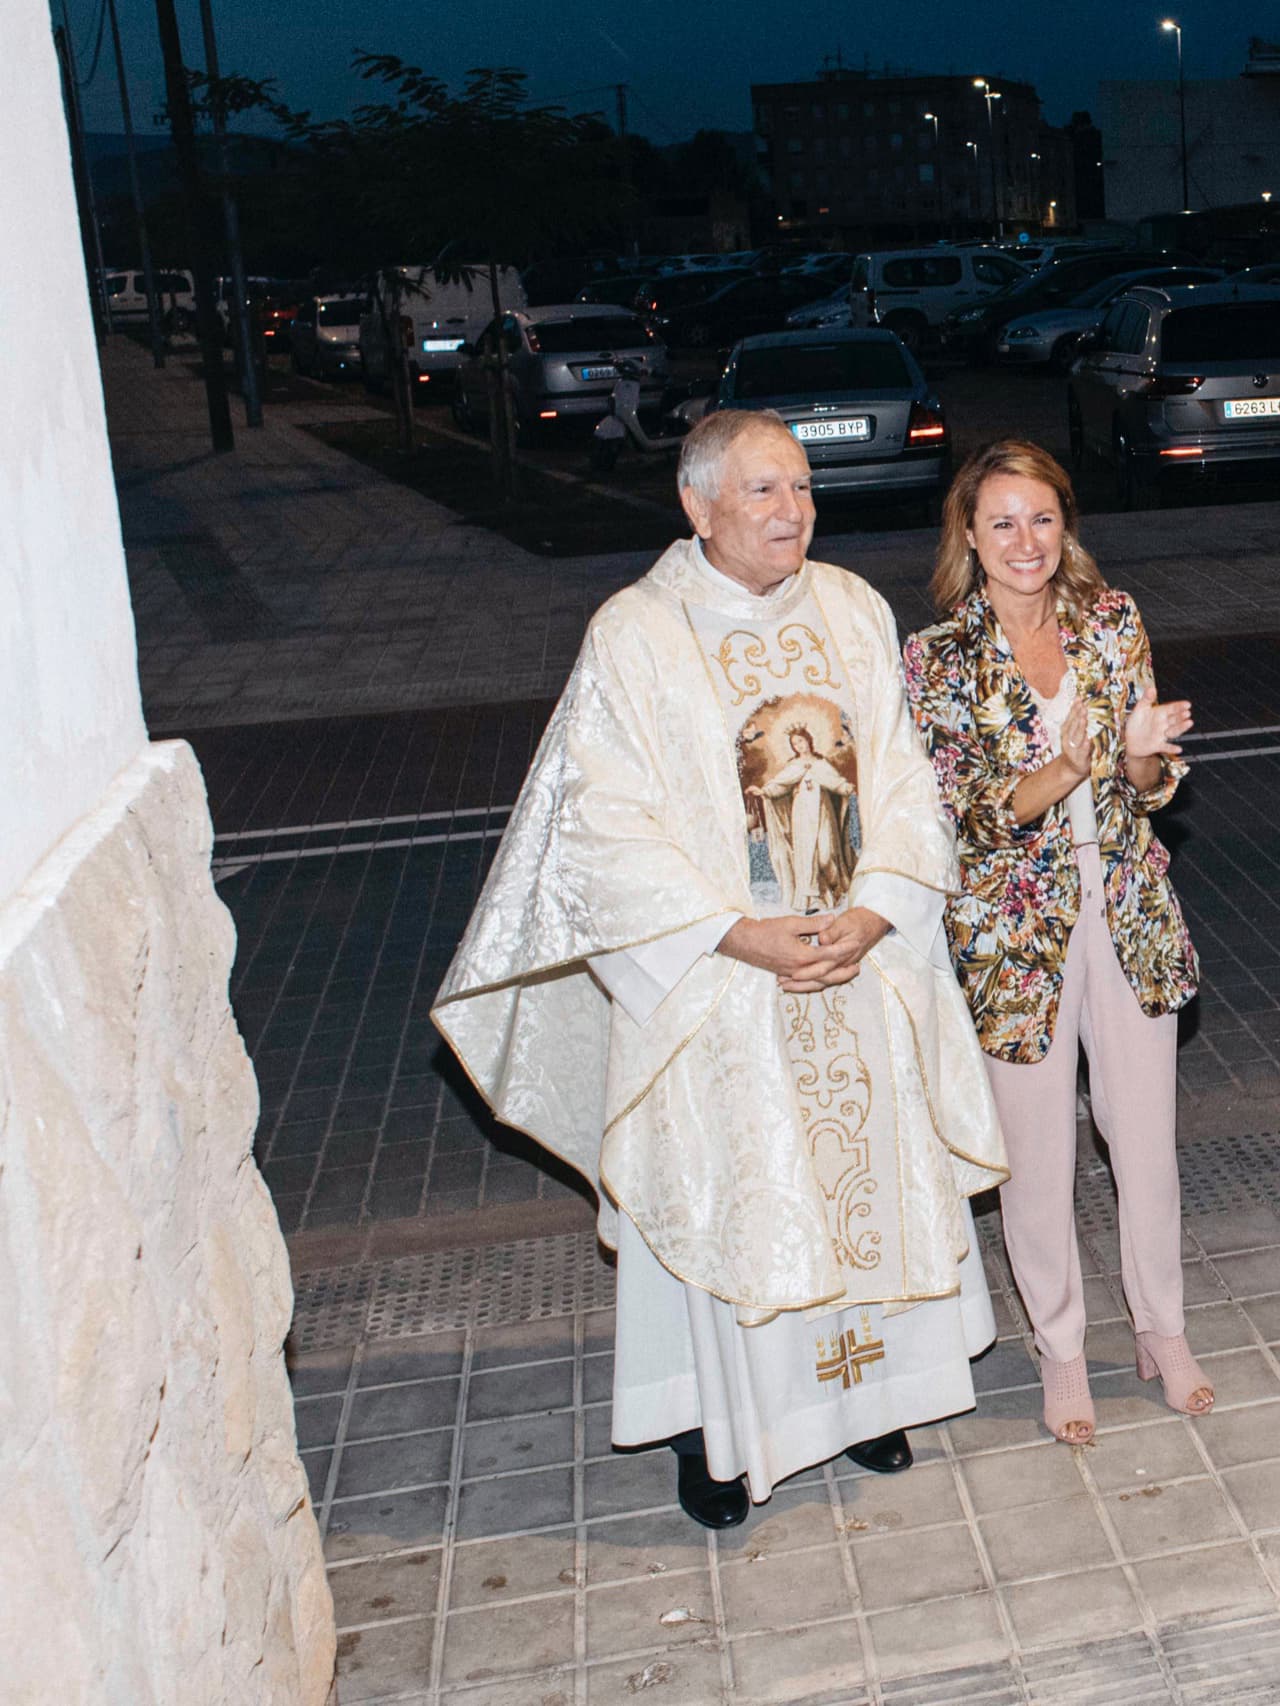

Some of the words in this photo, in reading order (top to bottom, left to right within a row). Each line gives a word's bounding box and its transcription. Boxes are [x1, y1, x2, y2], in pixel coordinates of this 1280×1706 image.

[1234, 401, 1267, 415] 6263
[800, 423, 835, 438] 3905
[838, 421, 864, 435] BYP
